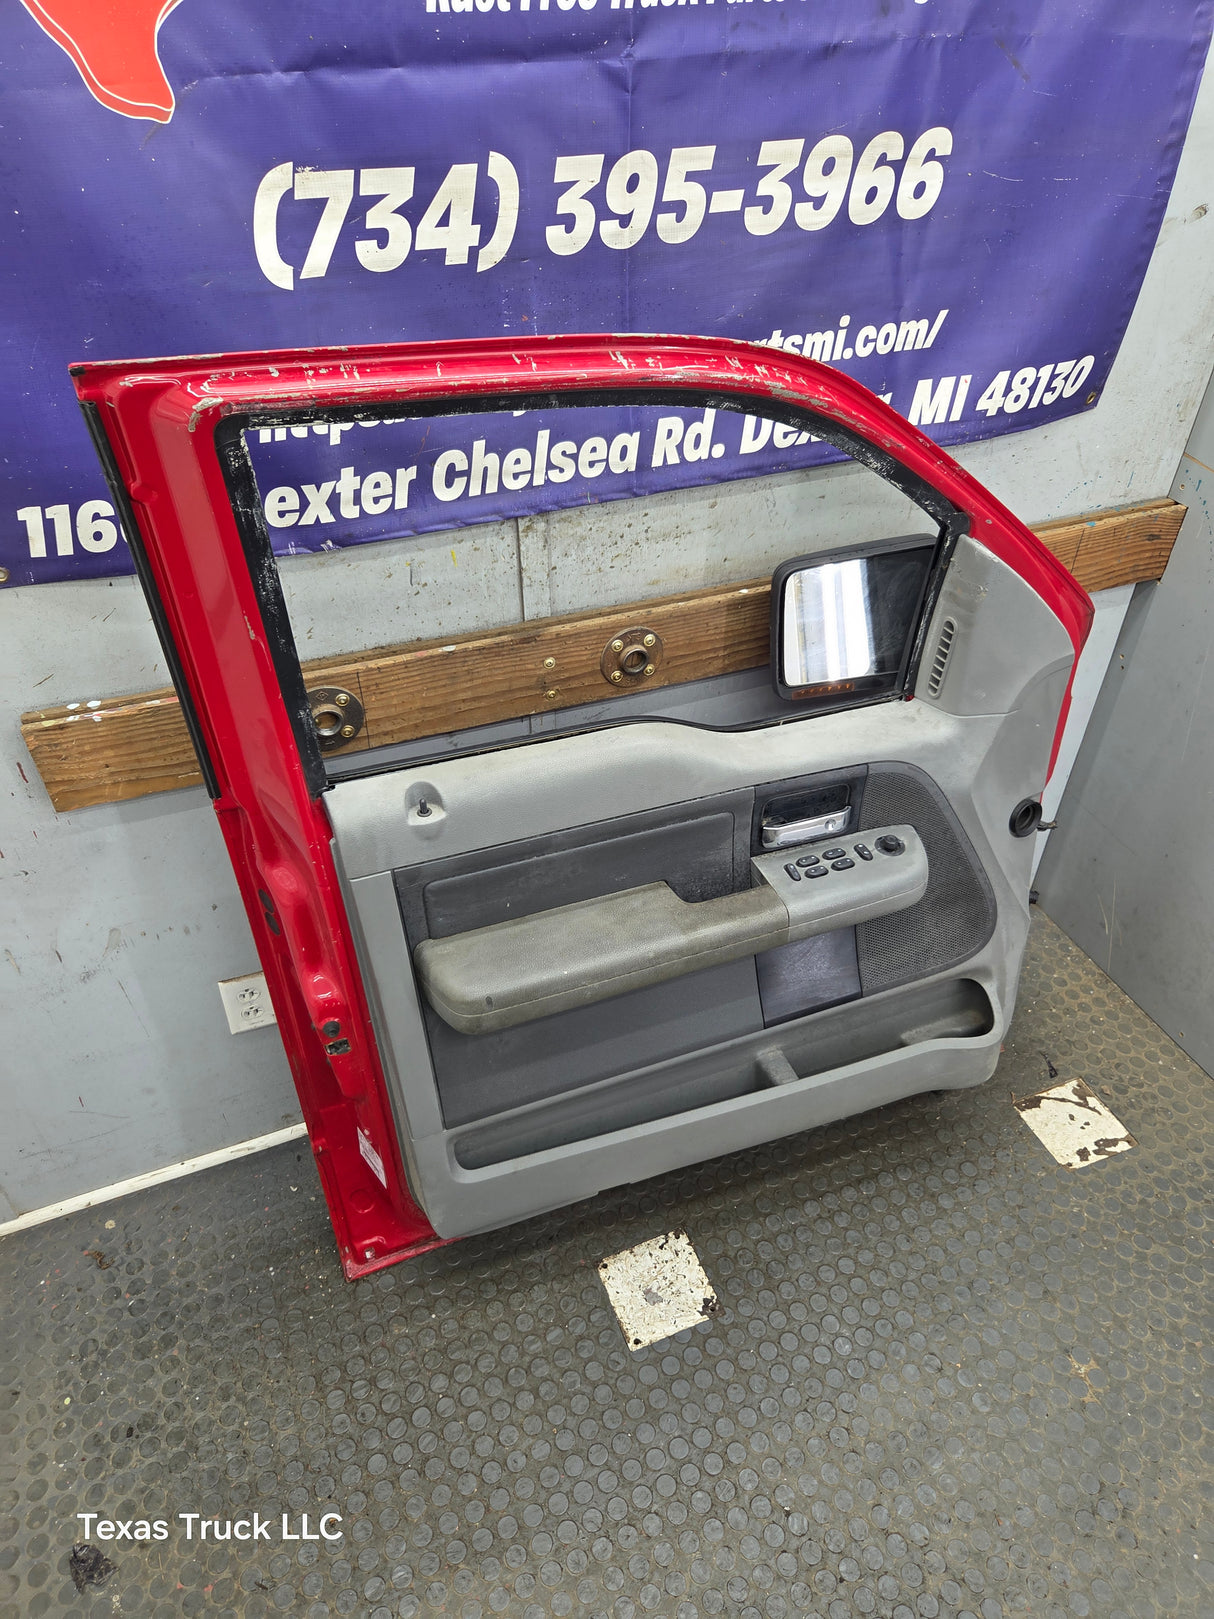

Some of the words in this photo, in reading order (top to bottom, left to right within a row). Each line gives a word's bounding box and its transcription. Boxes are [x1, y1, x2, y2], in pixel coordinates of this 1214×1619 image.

[253, 151, 520, 291] (734)
[545, 126, 954, 256] 395-3966
[16, 499, 127, 558] 116
[264, 465, 418, 528] exter
[432, 428, 641, 502] Chelsea
[650, 406, 726, 468] Rd.
[907, 374, 973, 426] MI
[975, 355, 1095, 417] 48130
